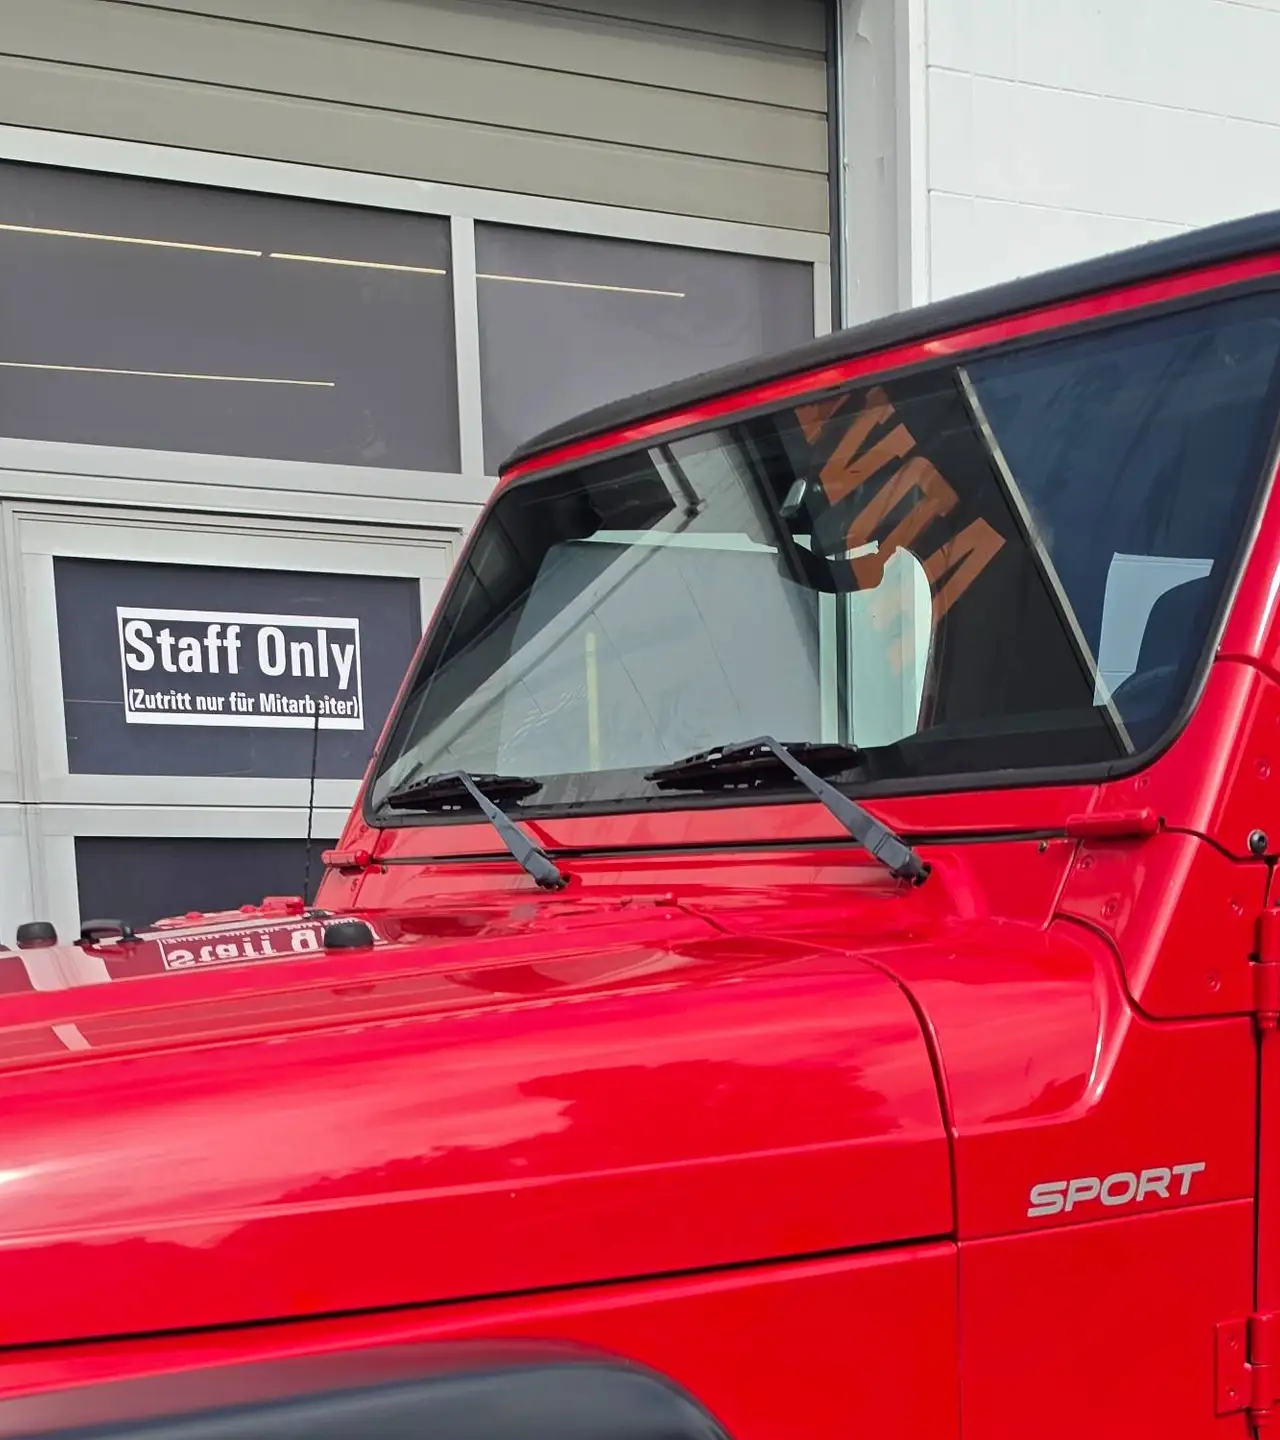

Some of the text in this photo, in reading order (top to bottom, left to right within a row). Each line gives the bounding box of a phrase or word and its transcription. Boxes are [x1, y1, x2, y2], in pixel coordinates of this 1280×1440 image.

[124, 620, 355, 690] Staff Only
[128, 689, 359, 718] (Zutritt nur für Mitarbeiter)
[1026, 1161, 1206, 1218] SPORT
